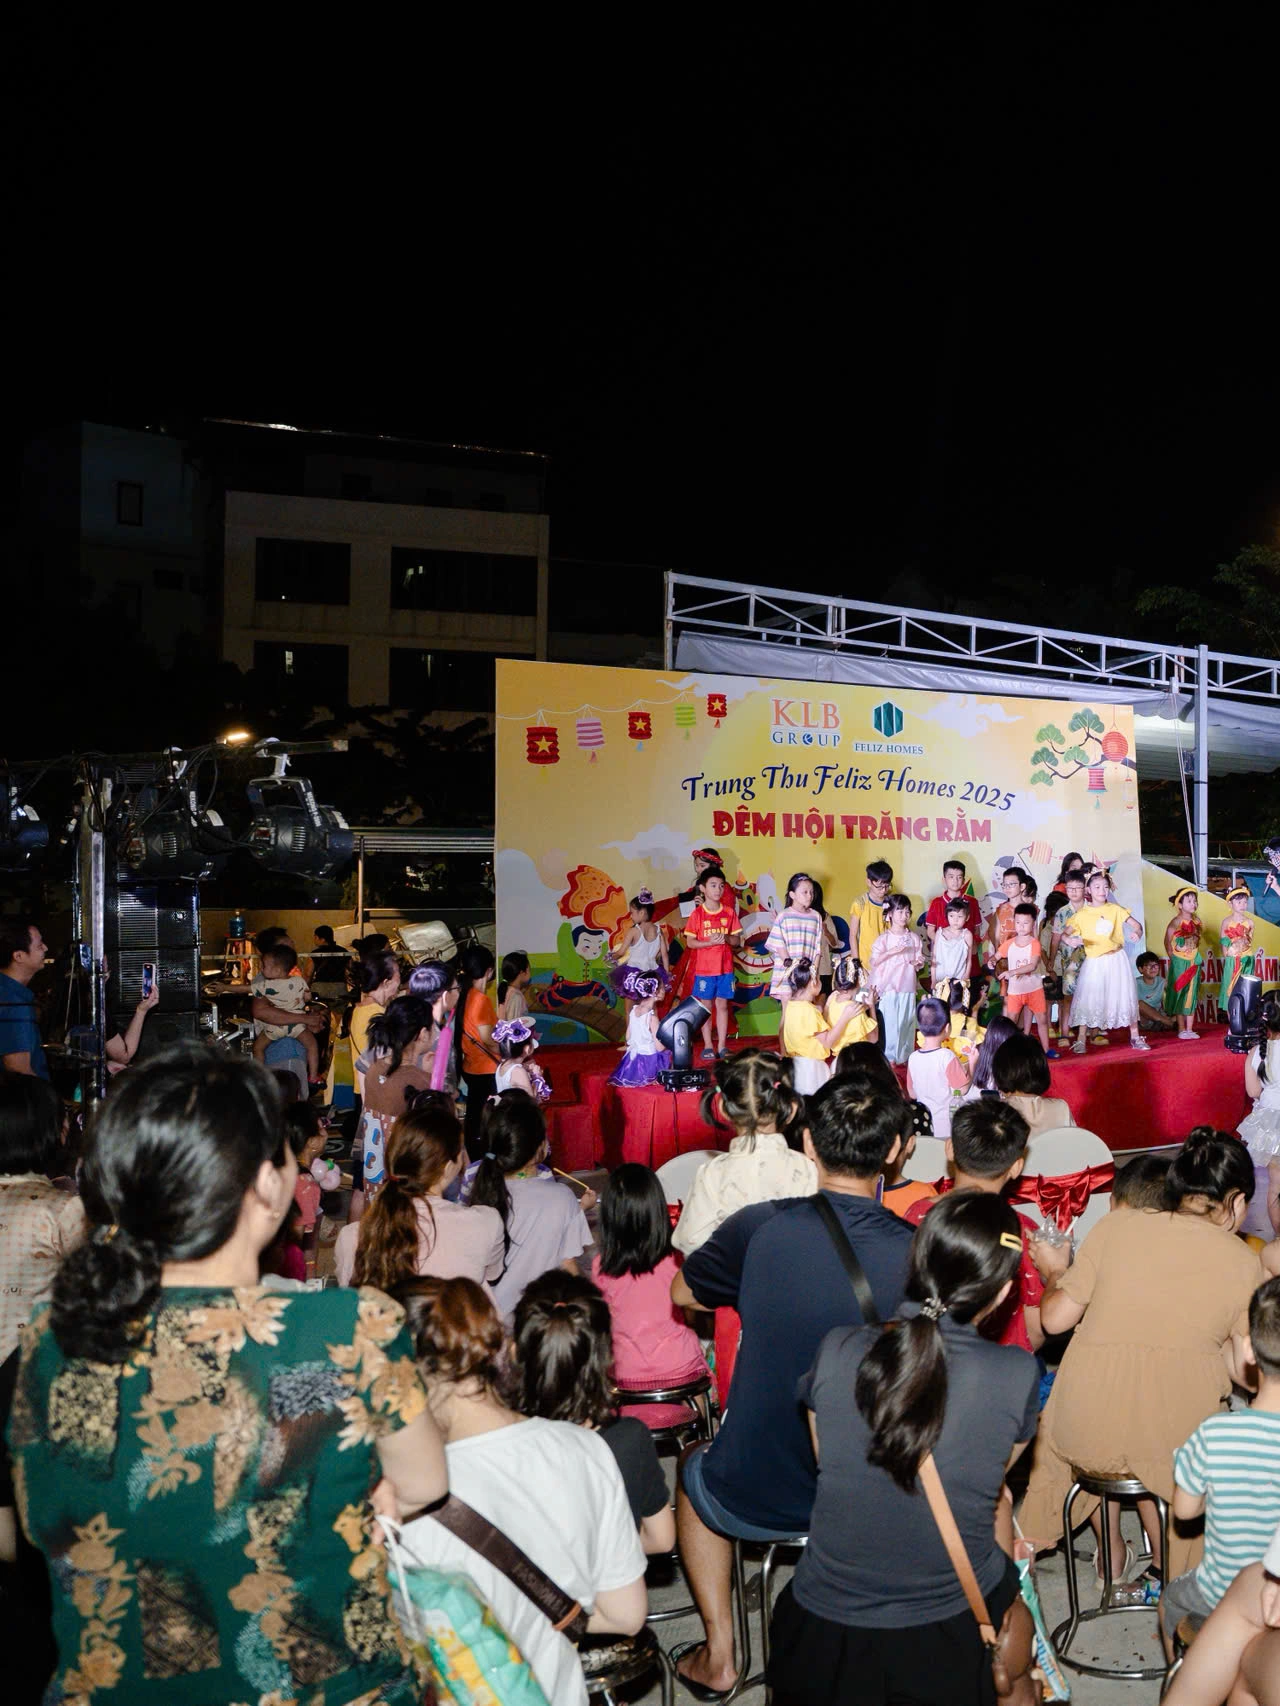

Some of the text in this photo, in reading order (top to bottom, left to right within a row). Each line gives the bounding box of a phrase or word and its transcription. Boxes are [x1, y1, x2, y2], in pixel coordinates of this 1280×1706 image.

[772, 698, 840, 729] KLB
[772, 731, 840, 747] GROUP
[855, 743, 924, 755] FELIZ HOMES
[681, 763, 1016, 811] Trung Thu Feliz Homes 2025
[712, 804, 992, 845] ĐÊM HỘI TRĂNG RẰM
